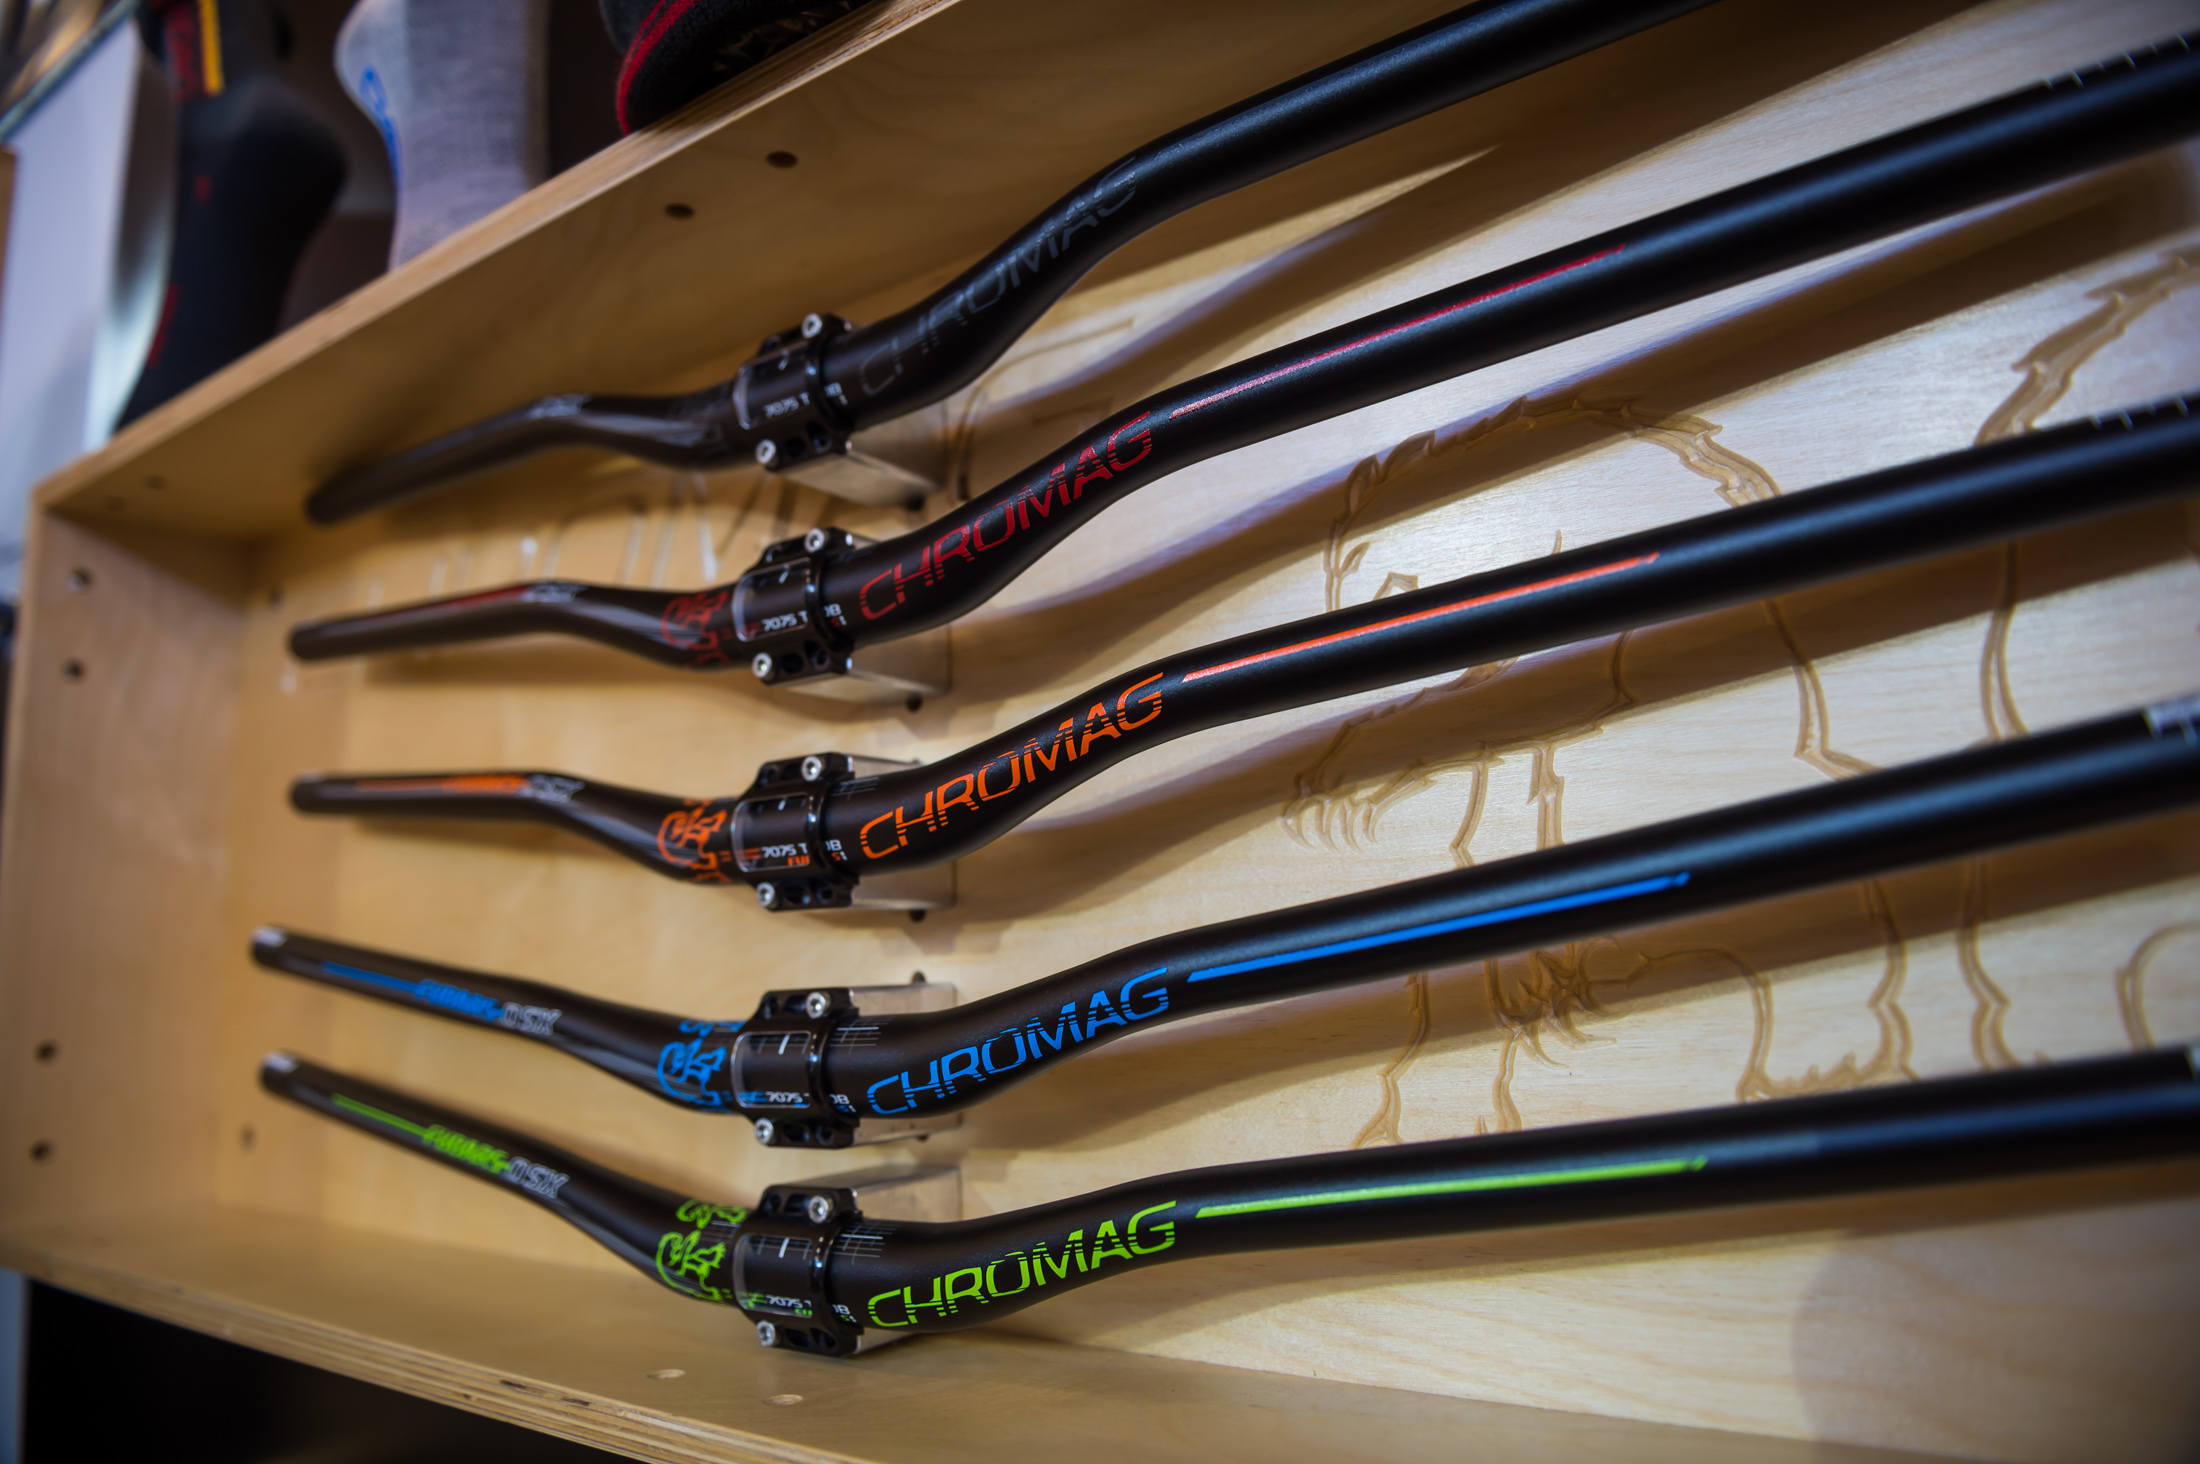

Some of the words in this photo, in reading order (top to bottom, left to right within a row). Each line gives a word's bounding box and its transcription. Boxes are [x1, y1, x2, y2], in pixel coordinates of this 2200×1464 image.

[763, 398, 799, 418] 7075
[859, 411, 1153, 620] CHROMAG
[762, 608, 797, 632] 7075
[798, 610, 809, 622] T
[860, 673, 1164, 860] CHROMAG
[762, 844, 797, 858] 7075
[797, 842, 808, 855] T
[867, 965, 1170, 1114] CHROMAG
[766, 1090, 803, 1103] 7075
[511, 1157, 569, 1199] OSX
[868, 1202, 1176, 1327] CHROMAG
[766, 1294, 803, 1309] 7075
